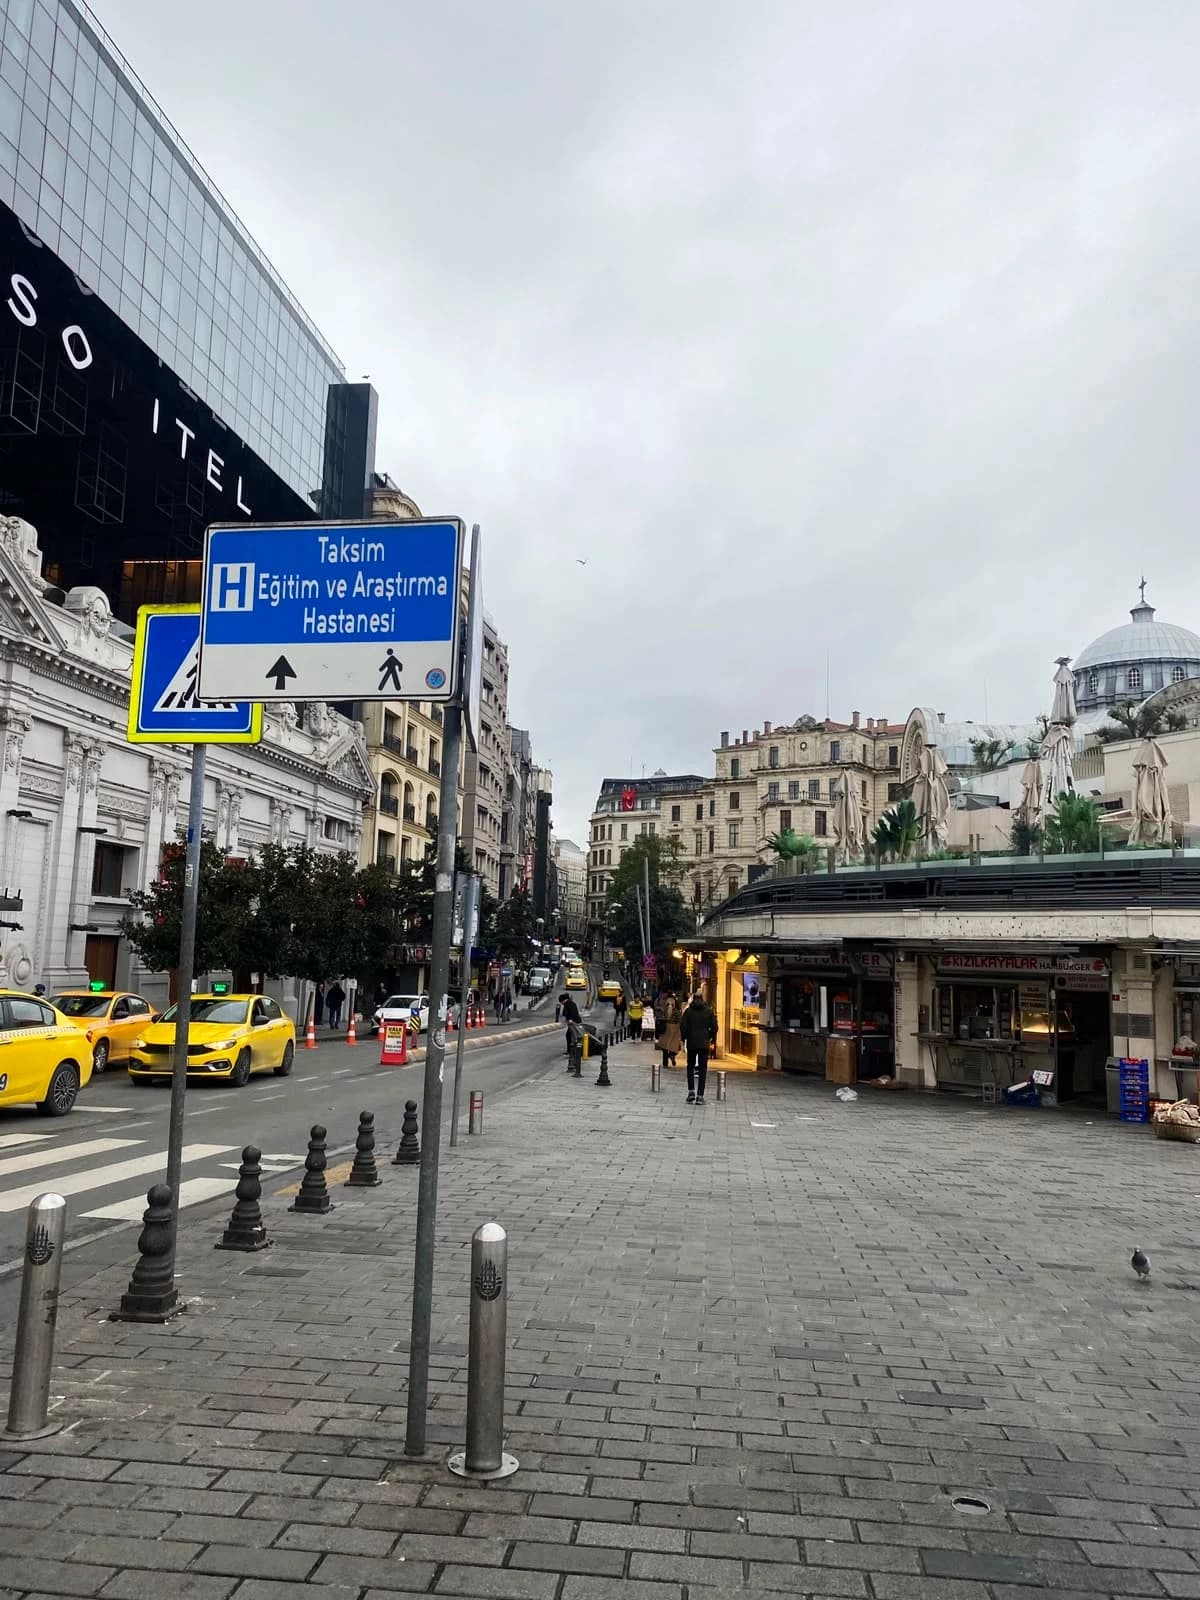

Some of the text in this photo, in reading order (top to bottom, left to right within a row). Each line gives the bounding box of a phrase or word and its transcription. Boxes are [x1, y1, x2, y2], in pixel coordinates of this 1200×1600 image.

[318, 536, 385, 564] Taksim
[218, 565, 249, 610] H
[258, 571, 448, 607] Eğitim ve Araştırma
[303, 607, 396, 634] Hastanesi
[952, 955, 1038, 969] KIZILKAYALAR
